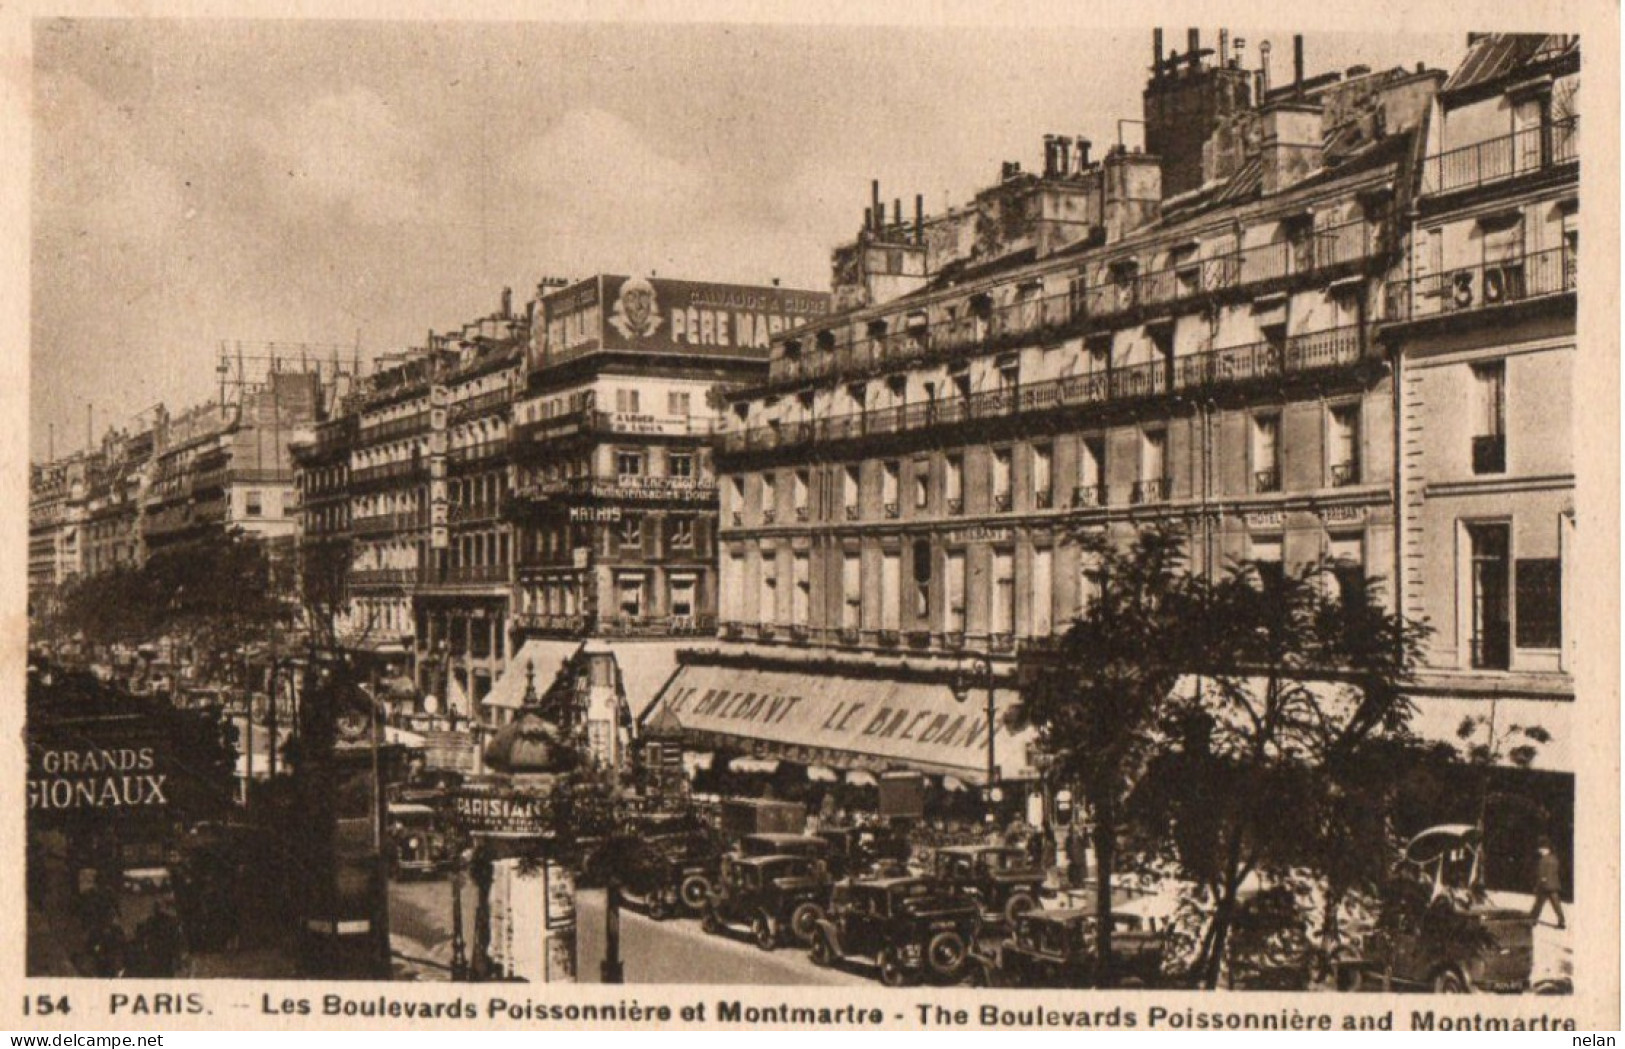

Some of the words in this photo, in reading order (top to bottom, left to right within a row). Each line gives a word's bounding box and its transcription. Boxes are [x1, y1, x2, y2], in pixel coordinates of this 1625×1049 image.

[670, 305, 730, 346] PÈRE
[569, 506, 622, 523] MATHIS
[822, 700, 866, 732] LE
[43, 748, 154, 774] GRANDS
